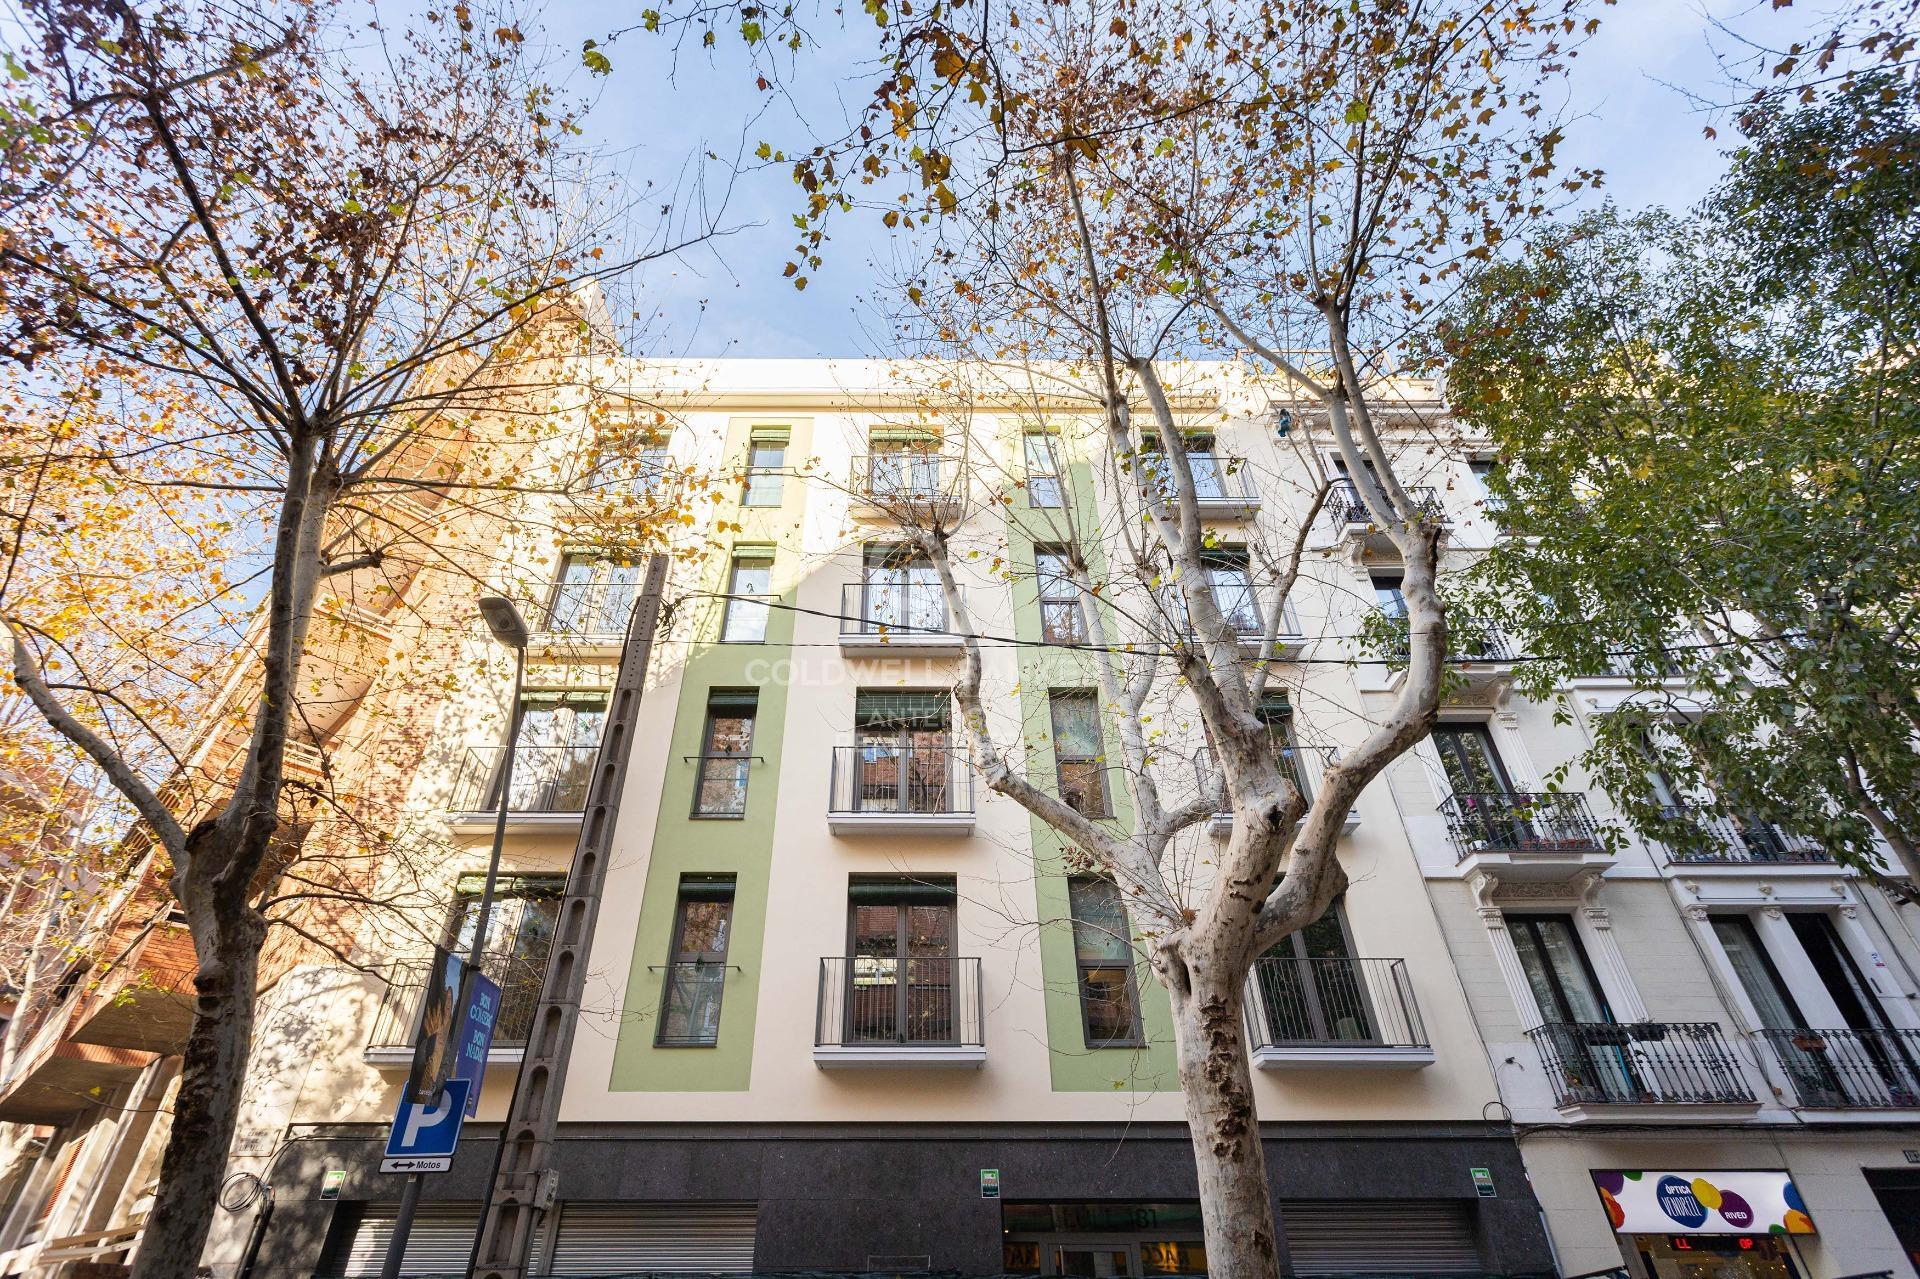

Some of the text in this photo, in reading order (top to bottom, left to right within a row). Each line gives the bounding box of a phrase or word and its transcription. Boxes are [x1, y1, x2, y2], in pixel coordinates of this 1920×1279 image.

[416, 1159, 441, 1170] Motos
[1661, 1195, 1702, 1217] VENDRELL
[1724, 1211, 1748, 1220] RIVED
